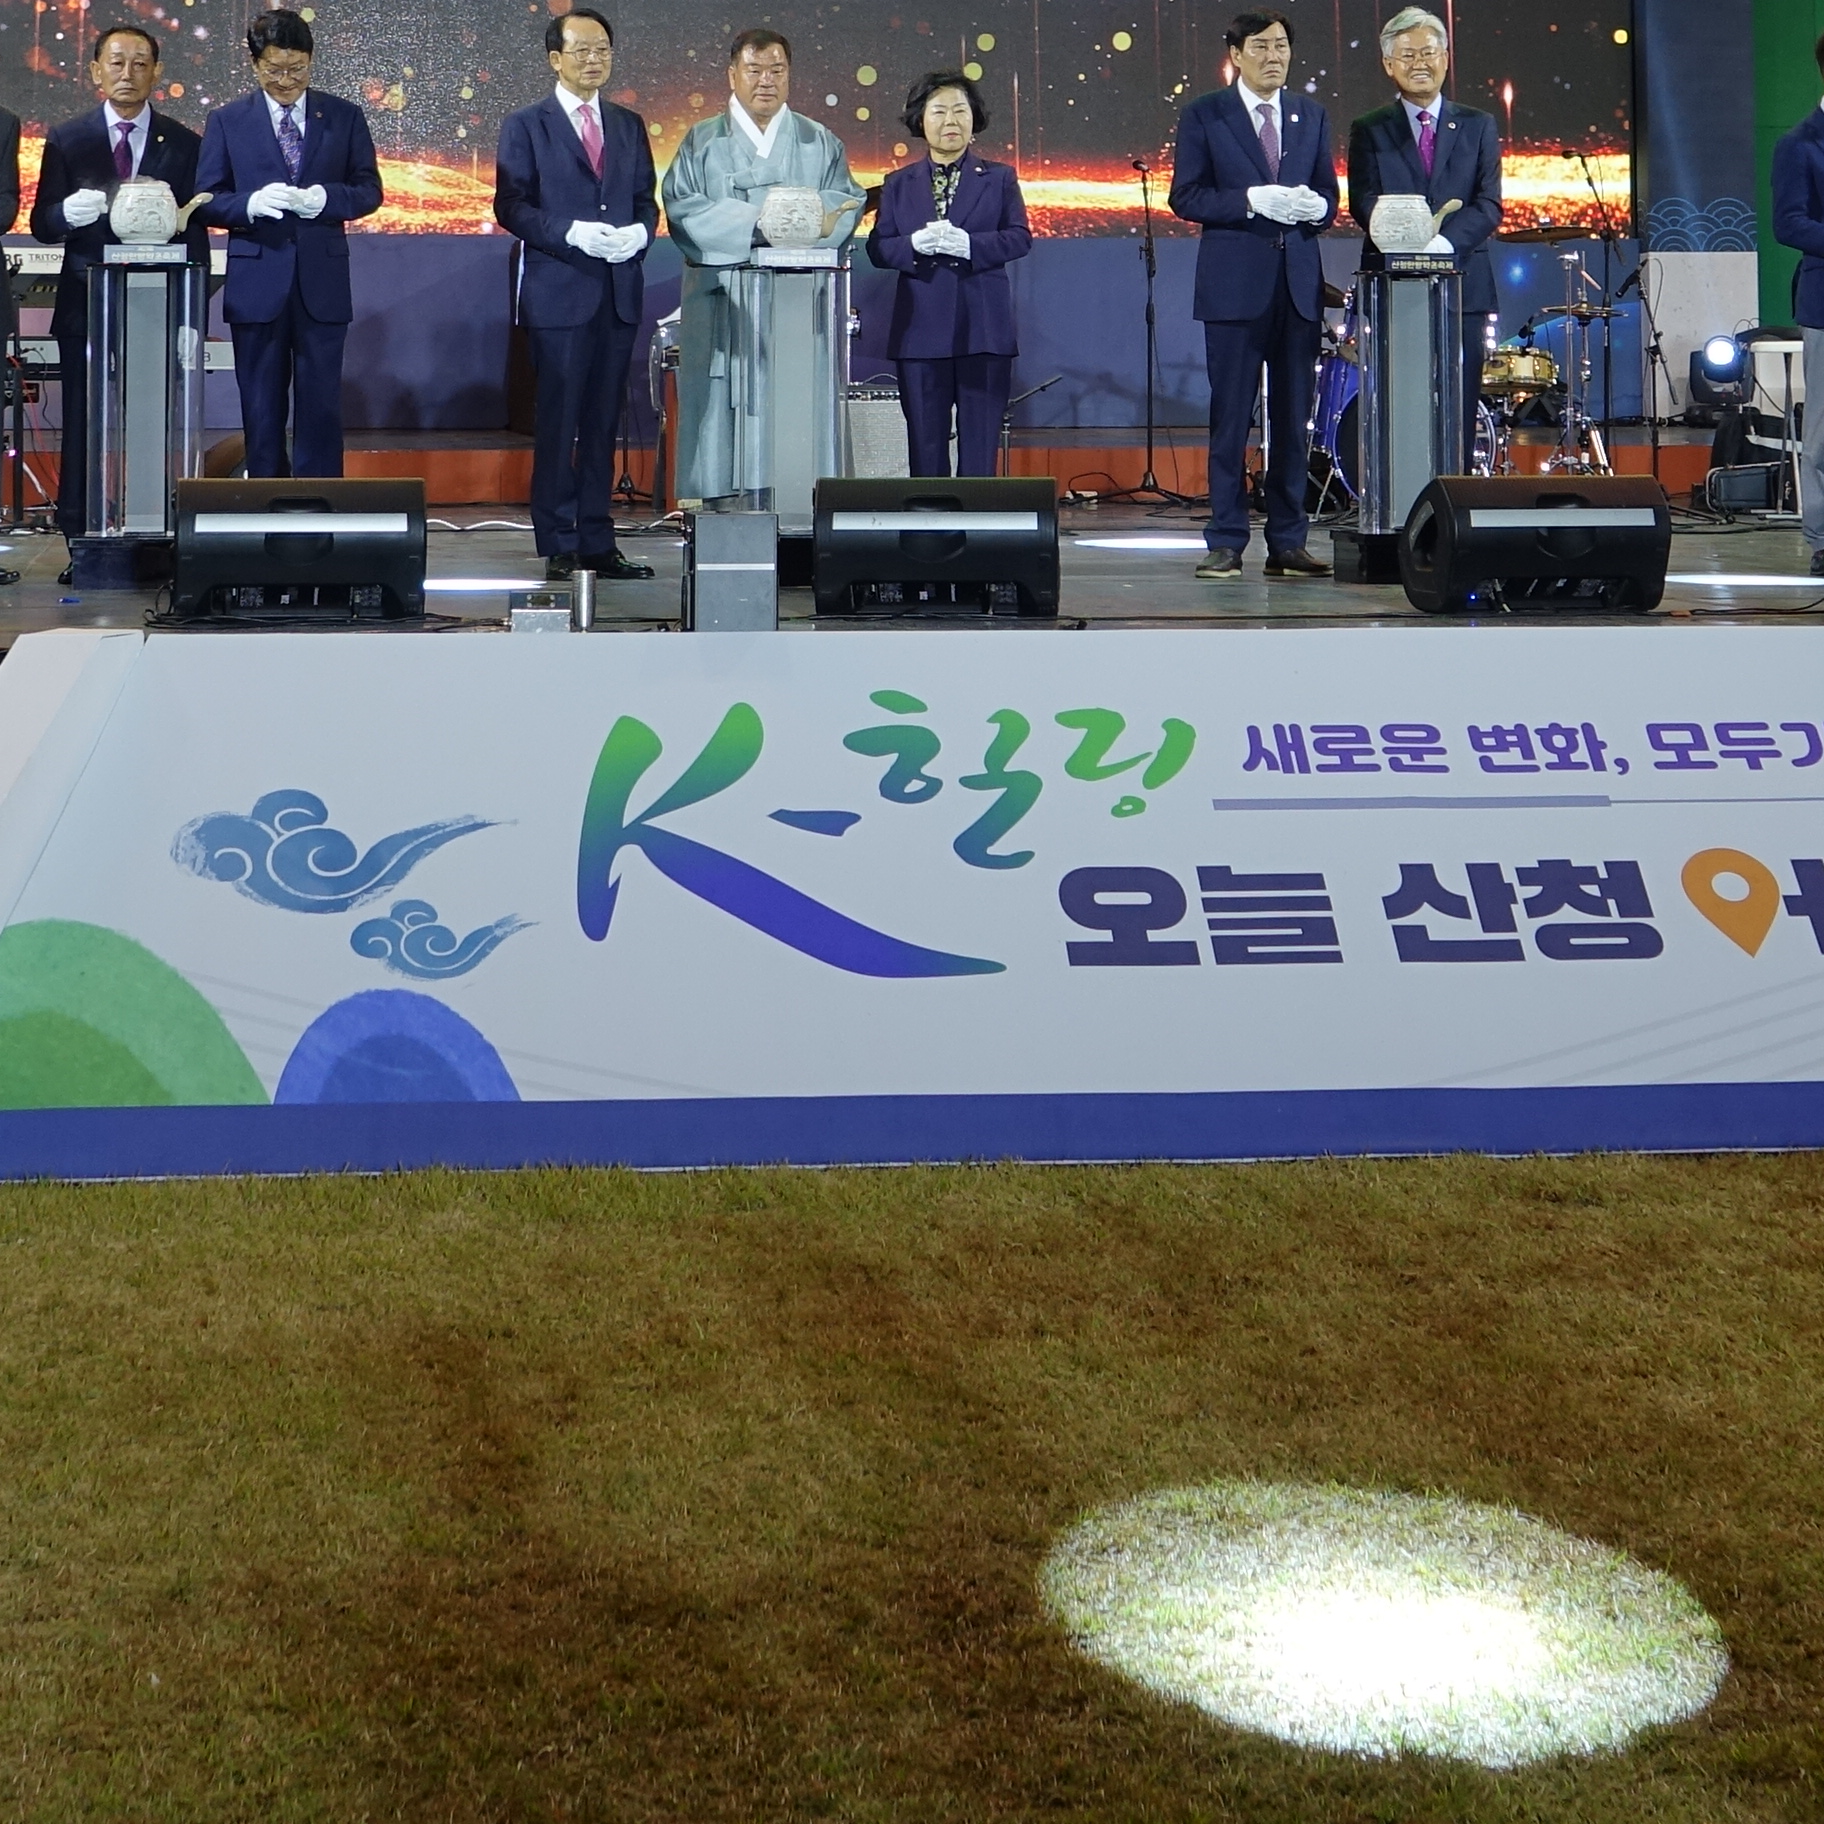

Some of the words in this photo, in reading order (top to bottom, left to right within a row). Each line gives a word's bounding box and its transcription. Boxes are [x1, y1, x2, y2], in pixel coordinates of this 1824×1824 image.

[1242, 722, 1451, 774] 새로운
[1465, 722, 1630, 776] 변화,
[1058, 865, 1344, 967] 오늘
[1381, 858, 1664, 963] 산청
